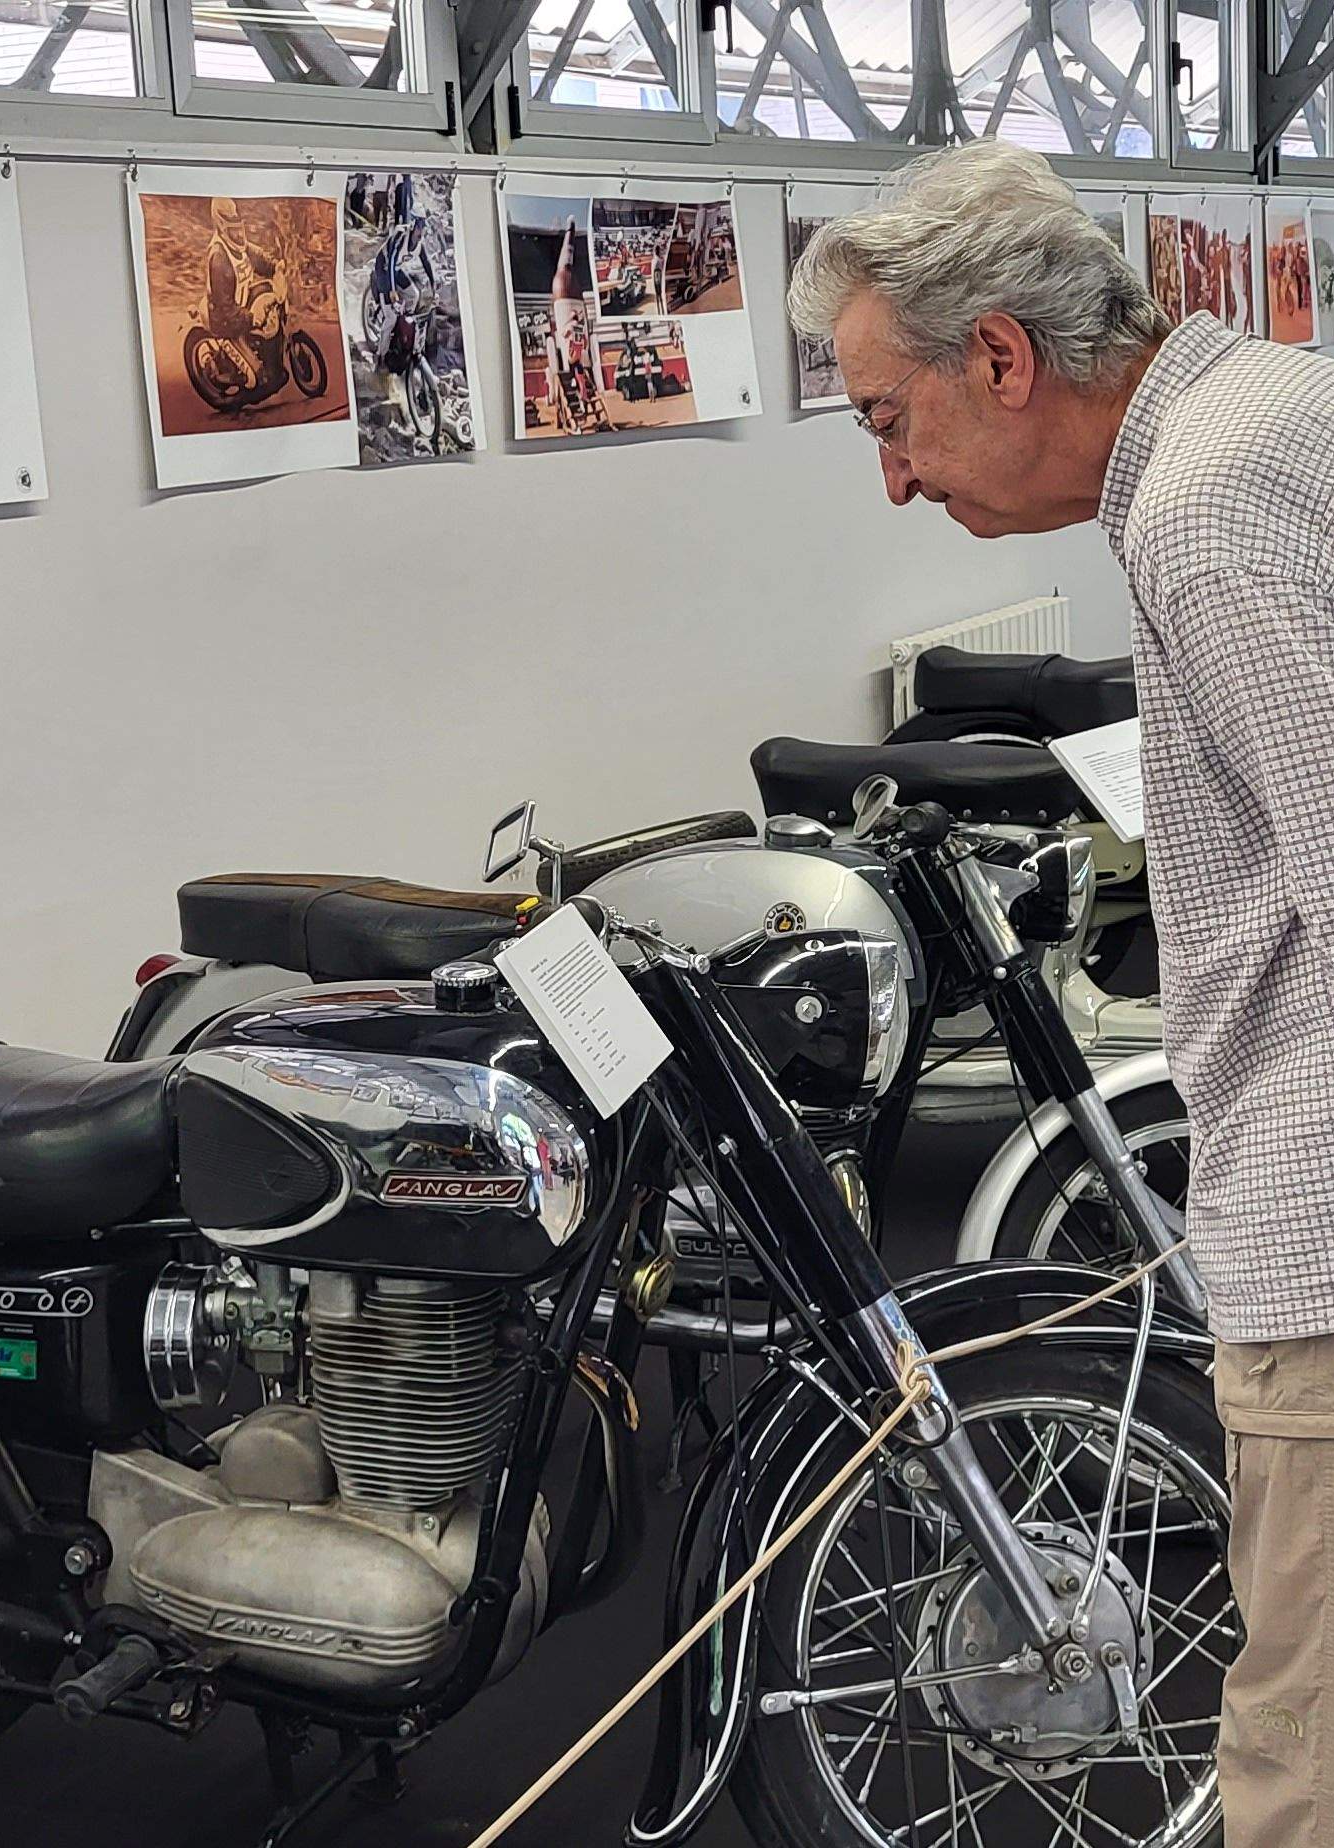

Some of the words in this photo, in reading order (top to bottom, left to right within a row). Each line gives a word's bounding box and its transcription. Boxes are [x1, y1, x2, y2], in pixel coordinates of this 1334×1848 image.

[389, 1182, 518, 1197] SANGLAS
[678, 1240, 749, 1255] BULTA
[215, 1618, 335, 1644] SANGLAS
